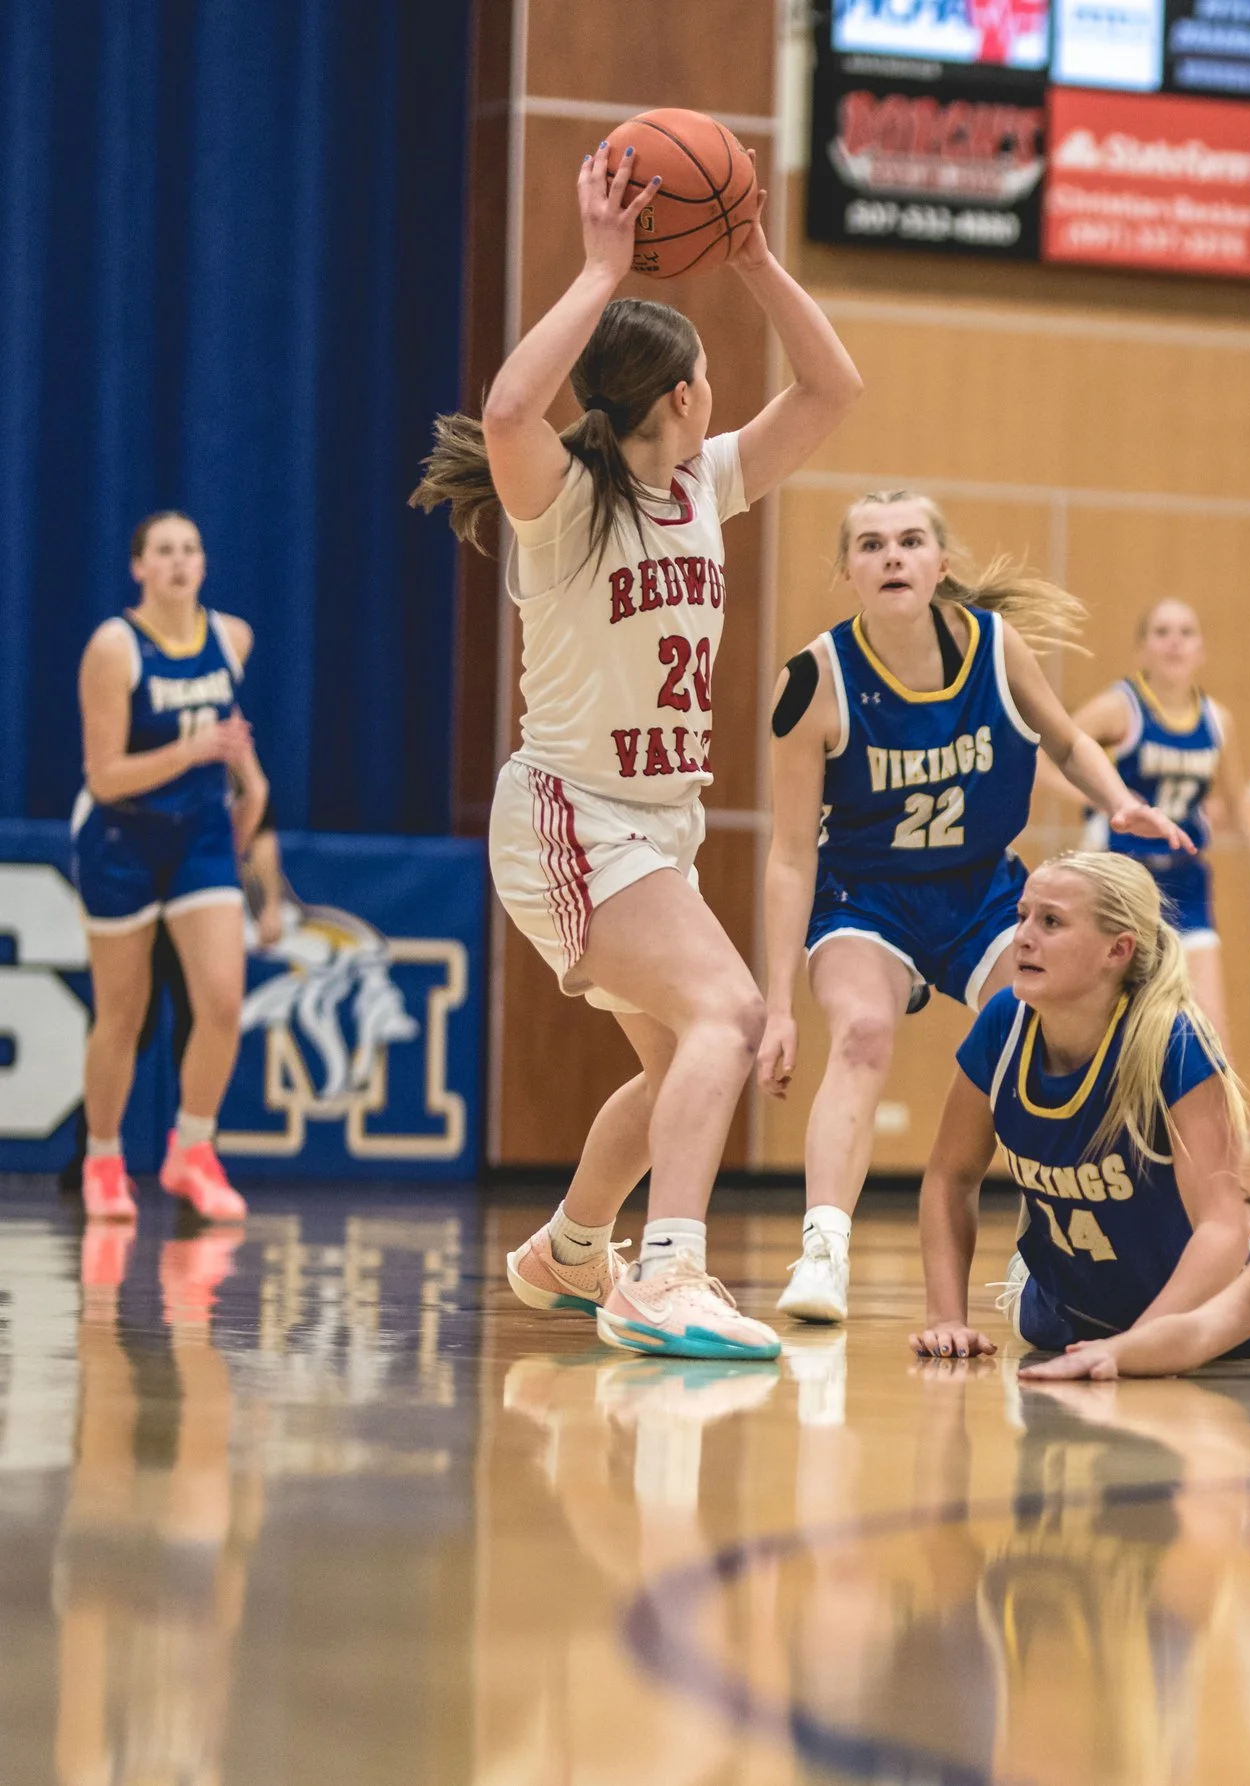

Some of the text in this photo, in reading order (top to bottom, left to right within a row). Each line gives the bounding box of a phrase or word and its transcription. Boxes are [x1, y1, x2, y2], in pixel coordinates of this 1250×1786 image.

[609, 556, 726, 624] REDWO
[866, 725, 993, 793] VIKINGS
[891, 786, 965, 849] 22
[1036, 1199, 1118, 1262] 14
